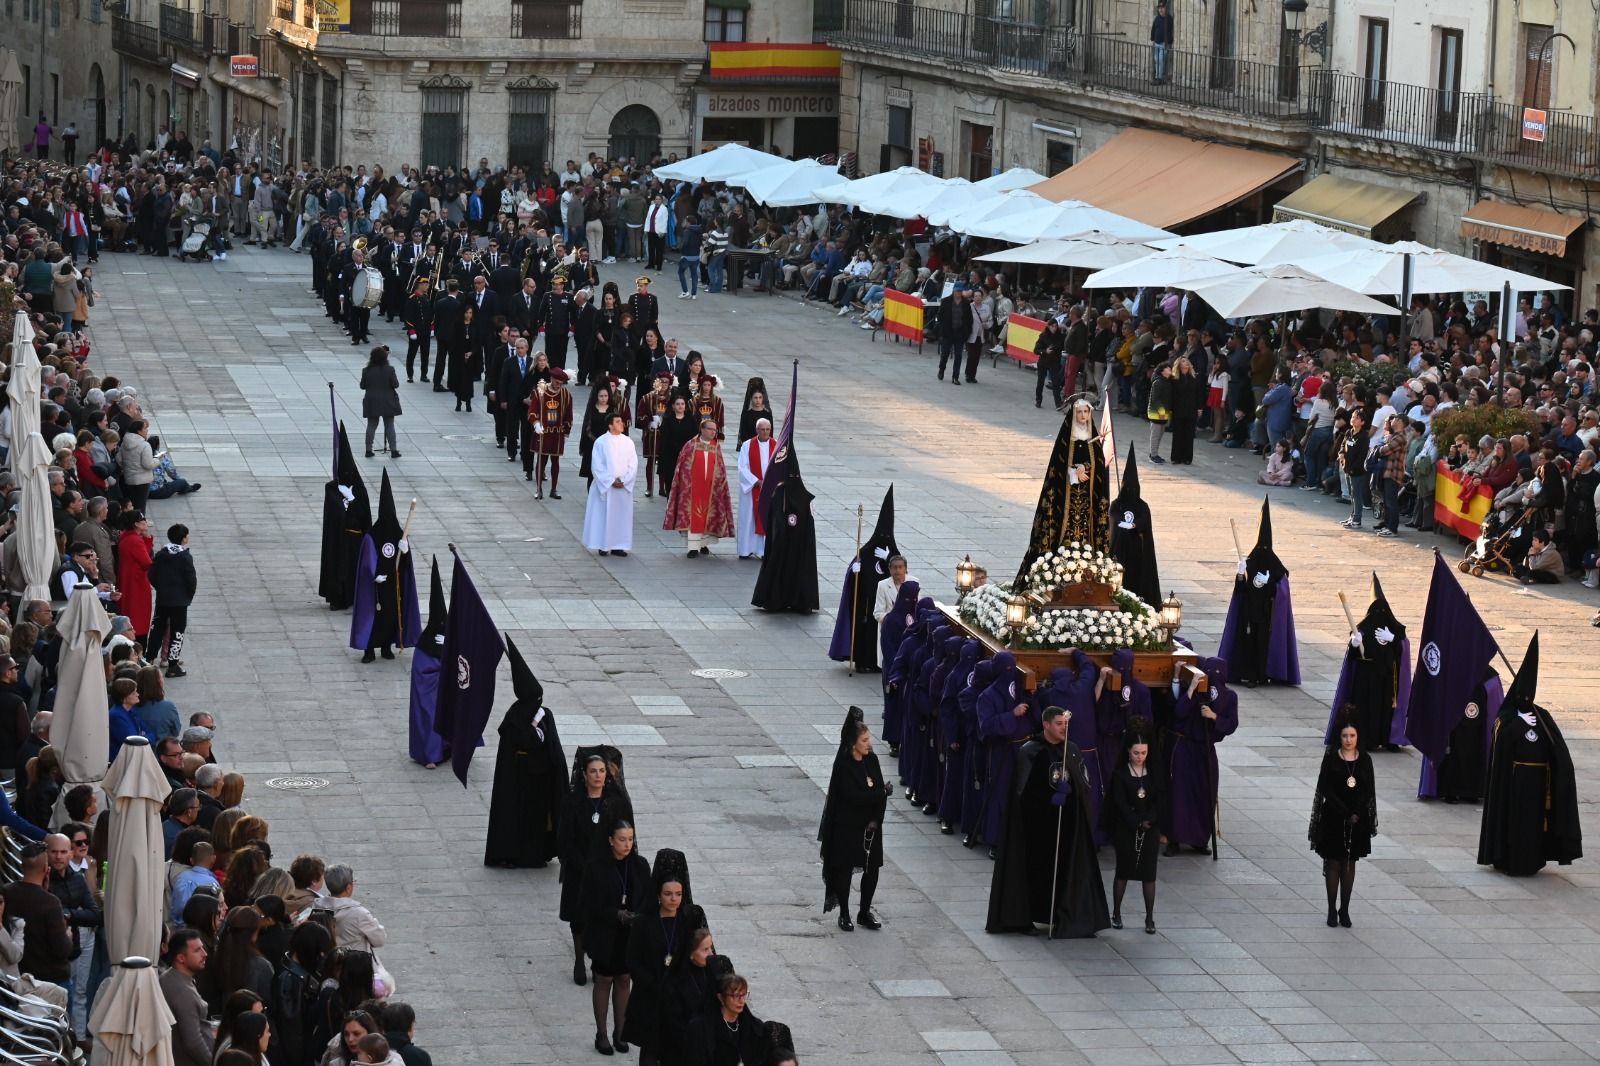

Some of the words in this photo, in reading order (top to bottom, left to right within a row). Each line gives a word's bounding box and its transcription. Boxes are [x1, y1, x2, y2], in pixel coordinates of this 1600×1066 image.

[708, 96, 760, 112] alzados
[767, 96, 834, 112] montero
[1524, 121, 1543, 130] VENDE
[1512, 232, 1534, 247] CAFE
[1541, 237, 1558, 252] BAR
